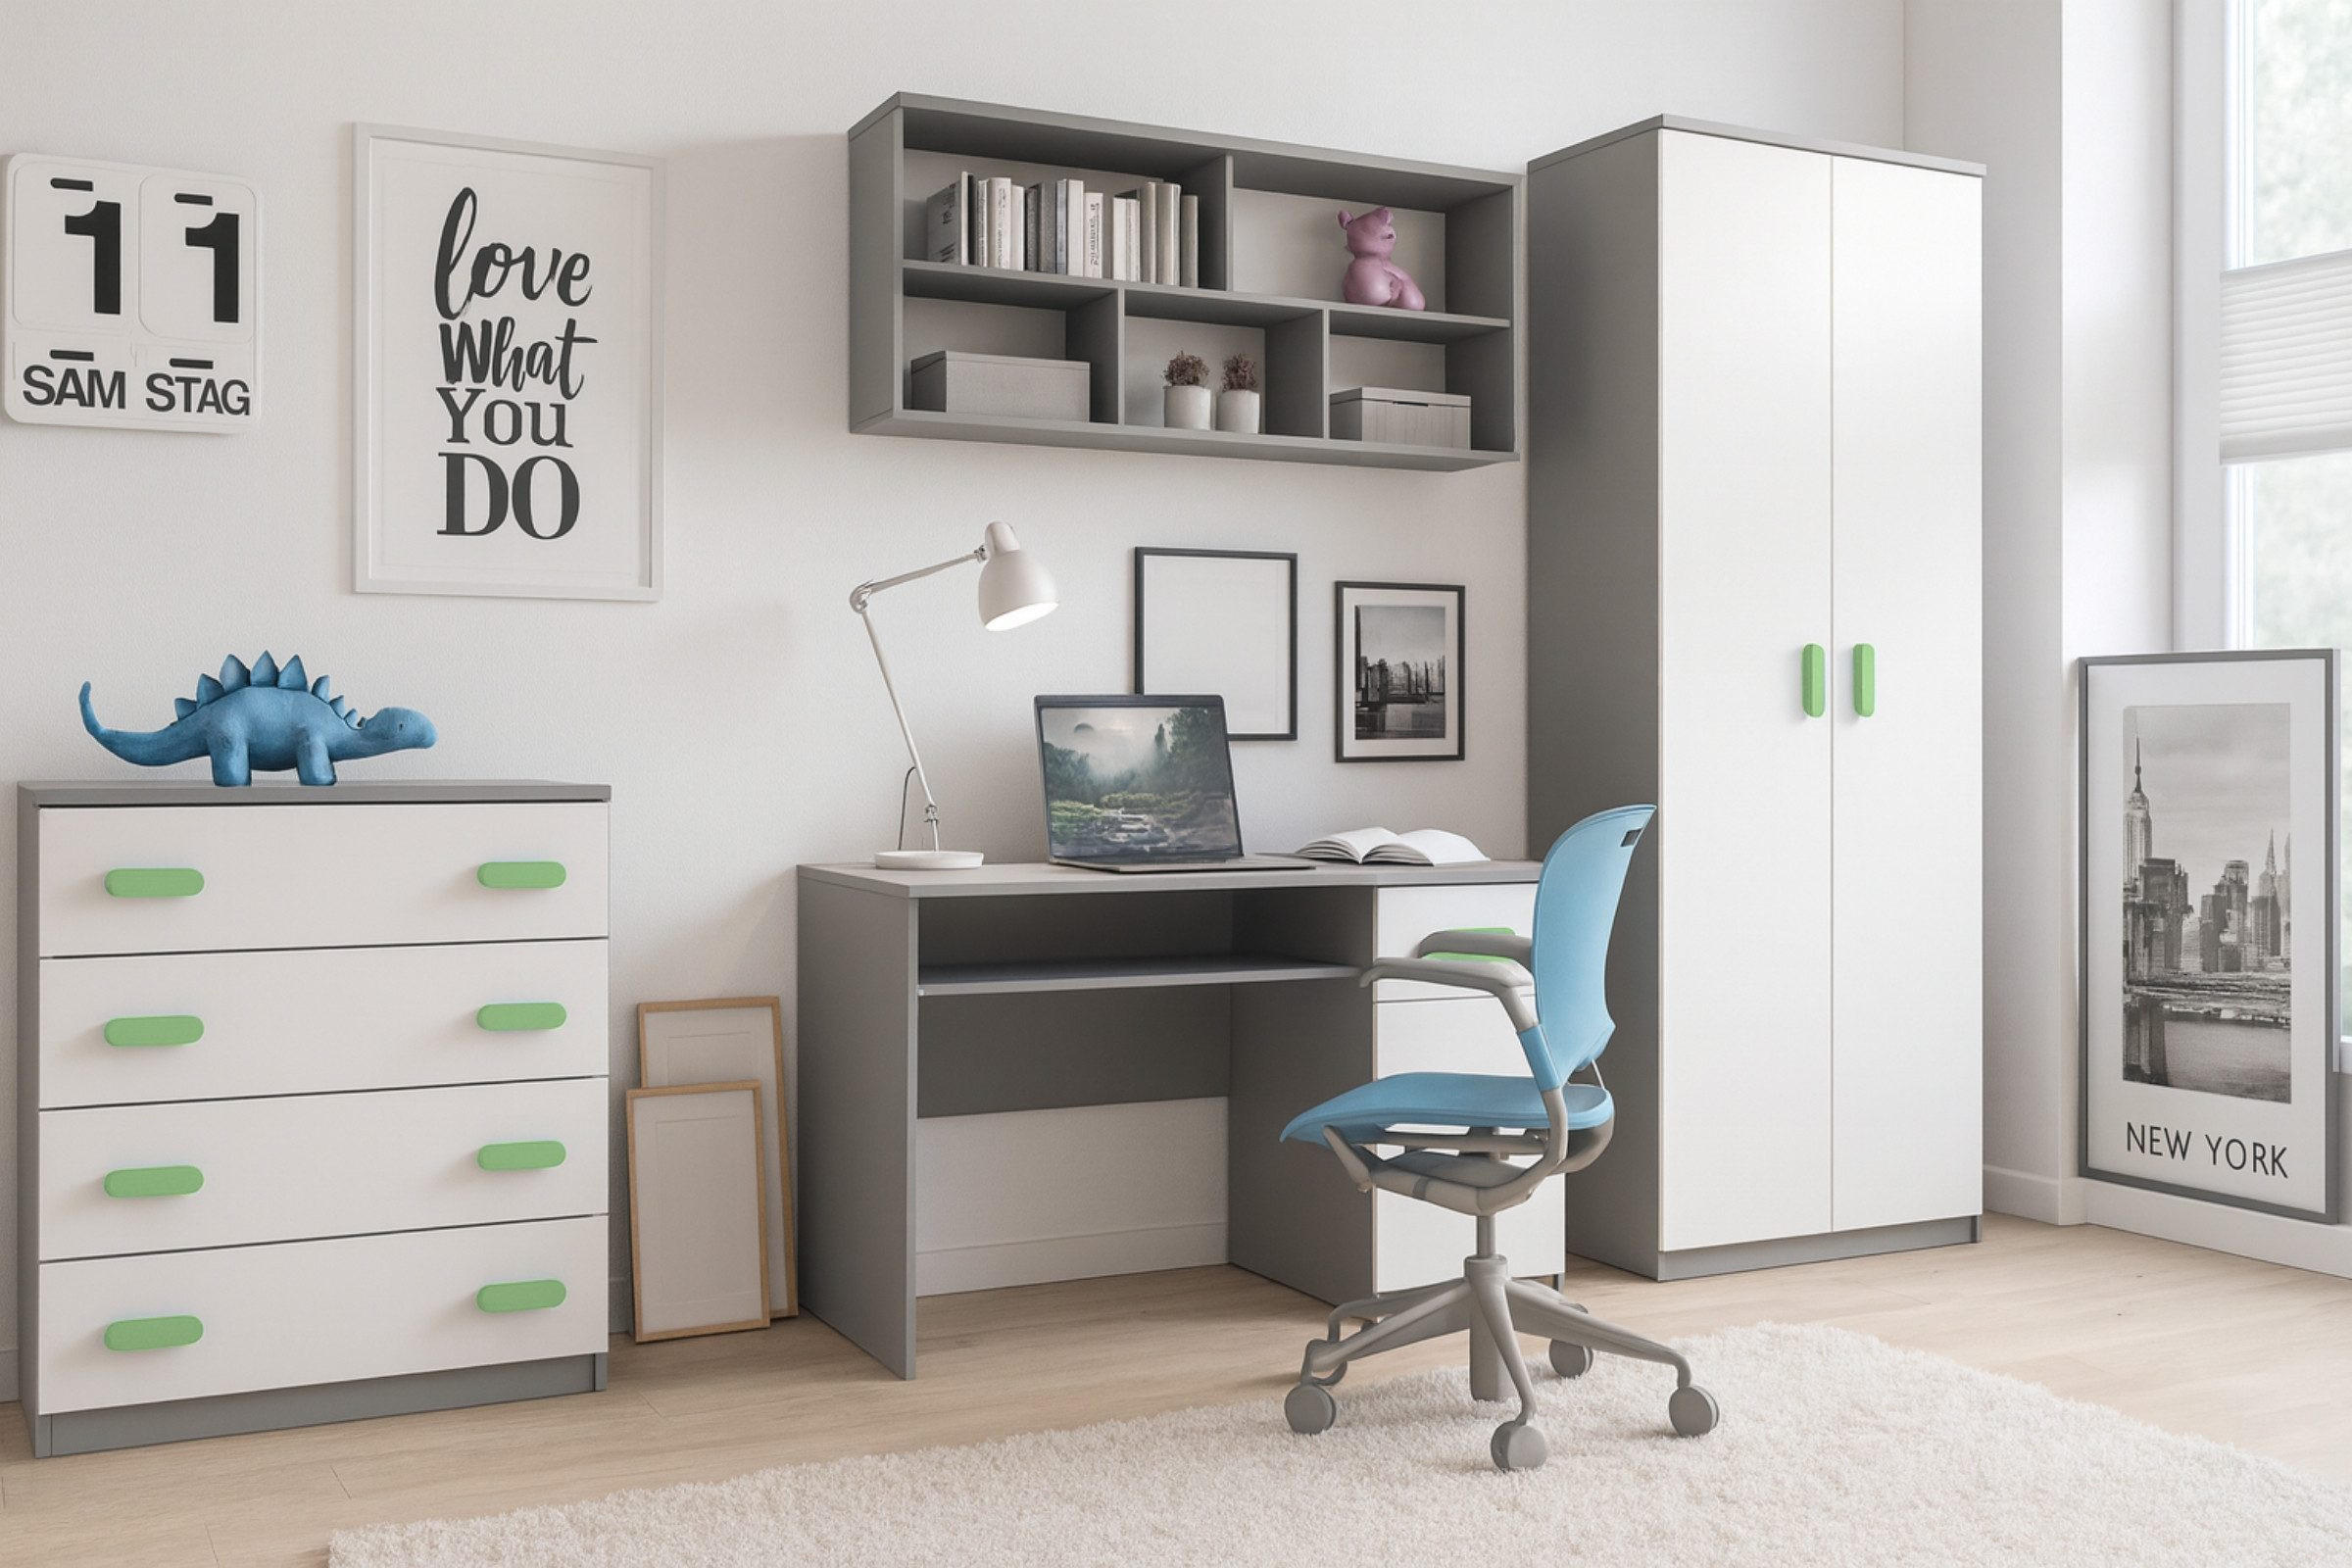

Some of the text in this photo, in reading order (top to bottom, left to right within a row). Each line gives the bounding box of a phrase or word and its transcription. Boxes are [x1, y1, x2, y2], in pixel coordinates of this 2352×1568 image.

[434, 186, 593, 320] love
[23, 365, 251, 416] SAM STAG
[438, 317, 598, 400] What
[436, 386, 574, 448] You
[436, 452, 580, 540] DO
[2127, 1121, 2288, 1179] NEW YORK
